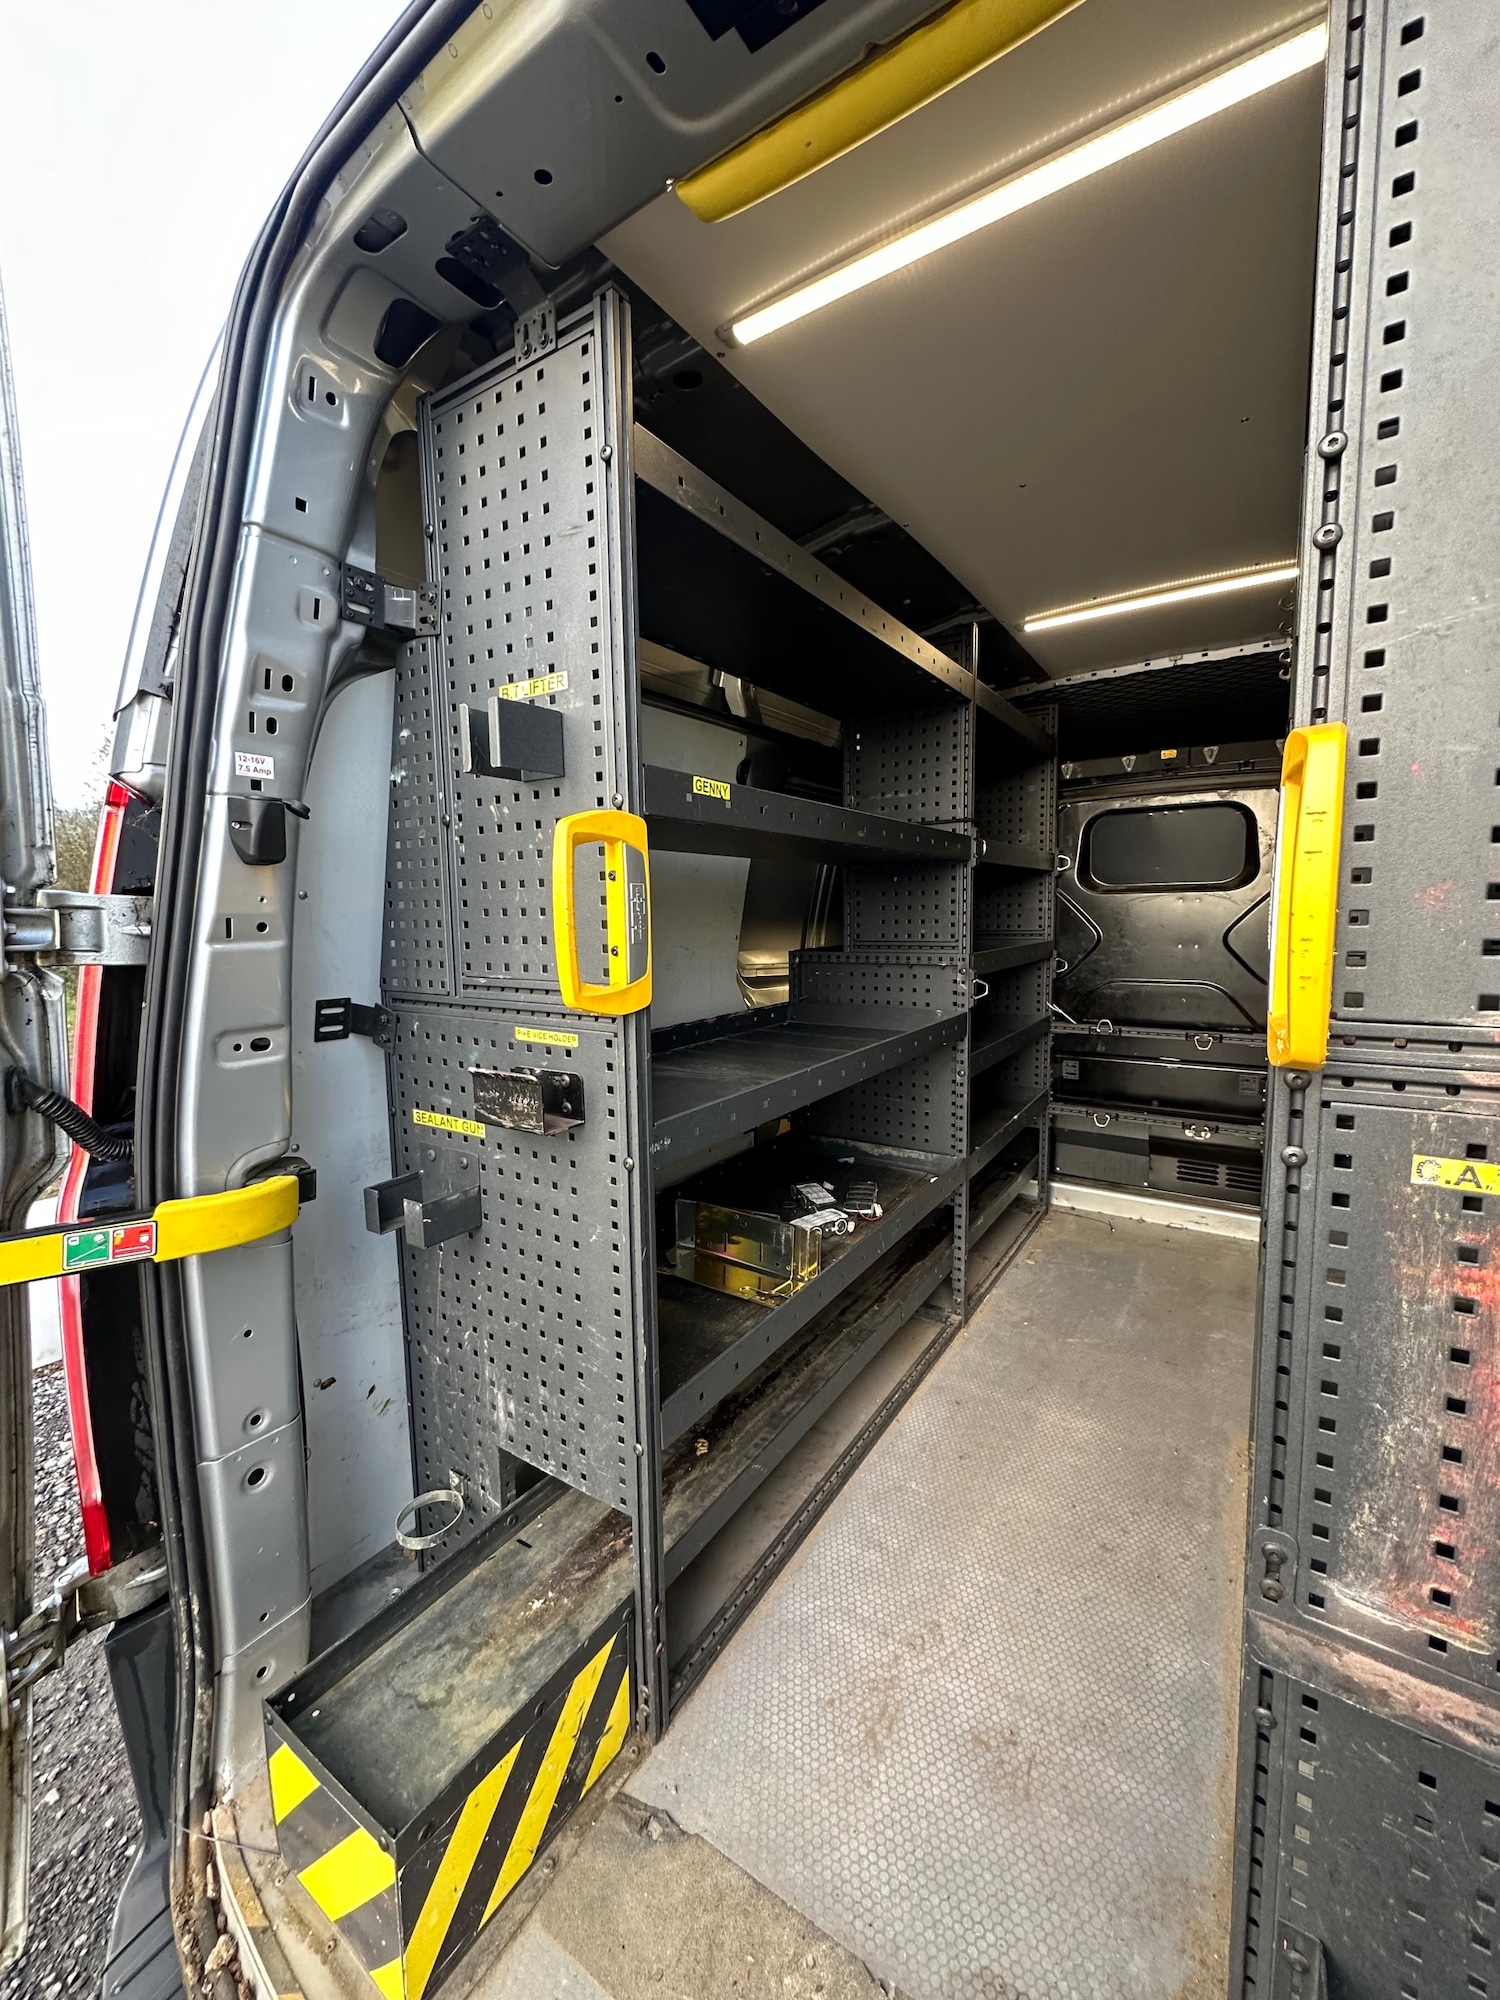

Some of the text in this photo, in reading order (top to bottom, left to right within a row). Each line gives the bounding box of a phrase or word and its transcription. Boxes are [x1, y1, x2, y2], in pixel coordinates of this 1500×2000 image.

[521, 674, 565, 696] LIFTER
[238, 755, 265, 765] 12-16V
[238, 764, 271, 776] 7.5 Amp
[695, 779, 728, 798] GENNY
[533, 1031, 547, 1040] VICE
[549, 1034, 576, 1043] HOLDER
[415, 1111, 484, 1136] SEALANT GUN
